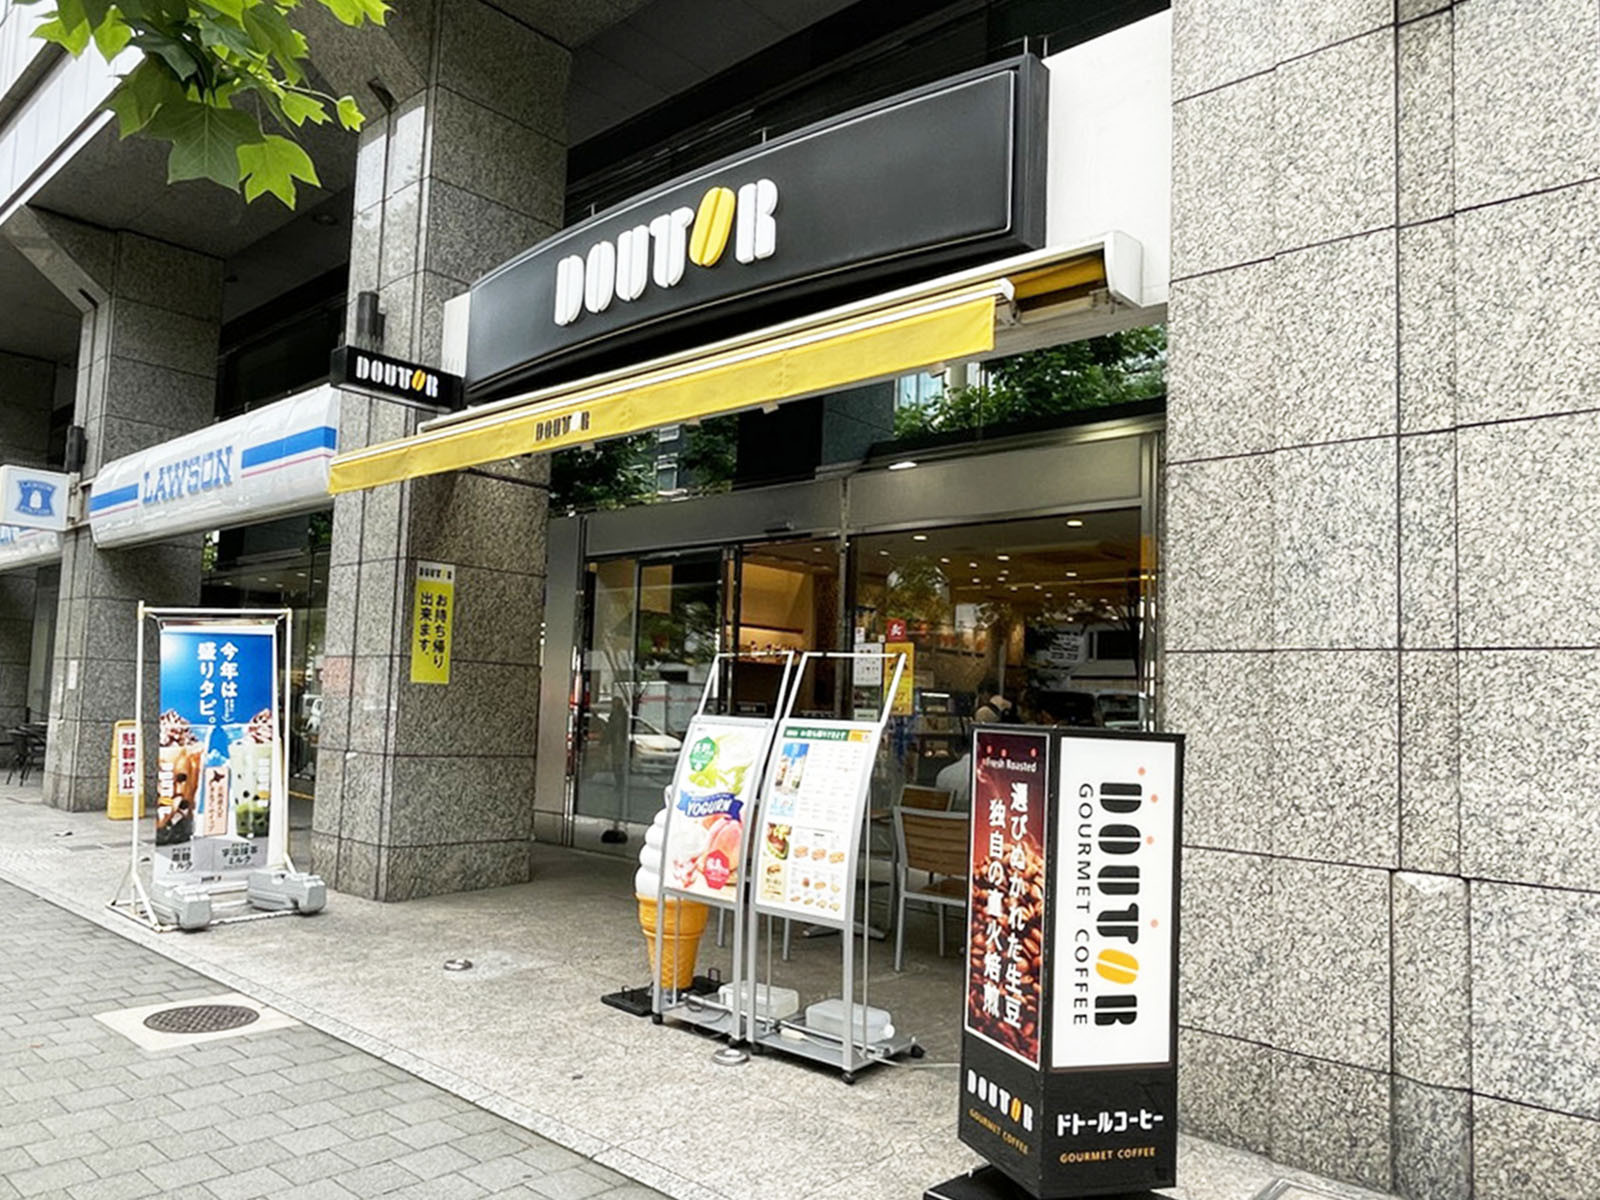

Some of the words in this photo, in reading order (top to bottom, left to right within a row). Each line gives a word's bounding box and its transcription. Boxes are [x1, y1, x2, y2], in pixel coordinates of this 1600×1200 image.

[554, 178, 778, 326] DOUTOR
[356, 355, 438, 398] DOUTOR
[142, 446, 233, 505] LAWSON
[433, 593, 448, 669] お持ち帰り
[220, 641, 239, 698] 今年は
[1075, 783, 1094, 914] GOURMET
[982, 799, 1007, 1018] 独自の直火焙煎
[1003, 782, 1029, 1029] 選びぬかれた生豆
[1094, 782, 1142, 1026] DOUTOR
[1073, 928, 1090, 1026] COFFEE
[967, 1069, 1034, 1132] DOUTOR
[968, 1108, 1001, 1138] GOURMET
[1002, 1130, 1029, 1155] COFFEE
[1056, 1108, 1164, 1137] ドトールコーヒー
[1059, 1149, 1114, 1164] GOURMET
[1116, 1147, 1156, 1160] COFFEE
